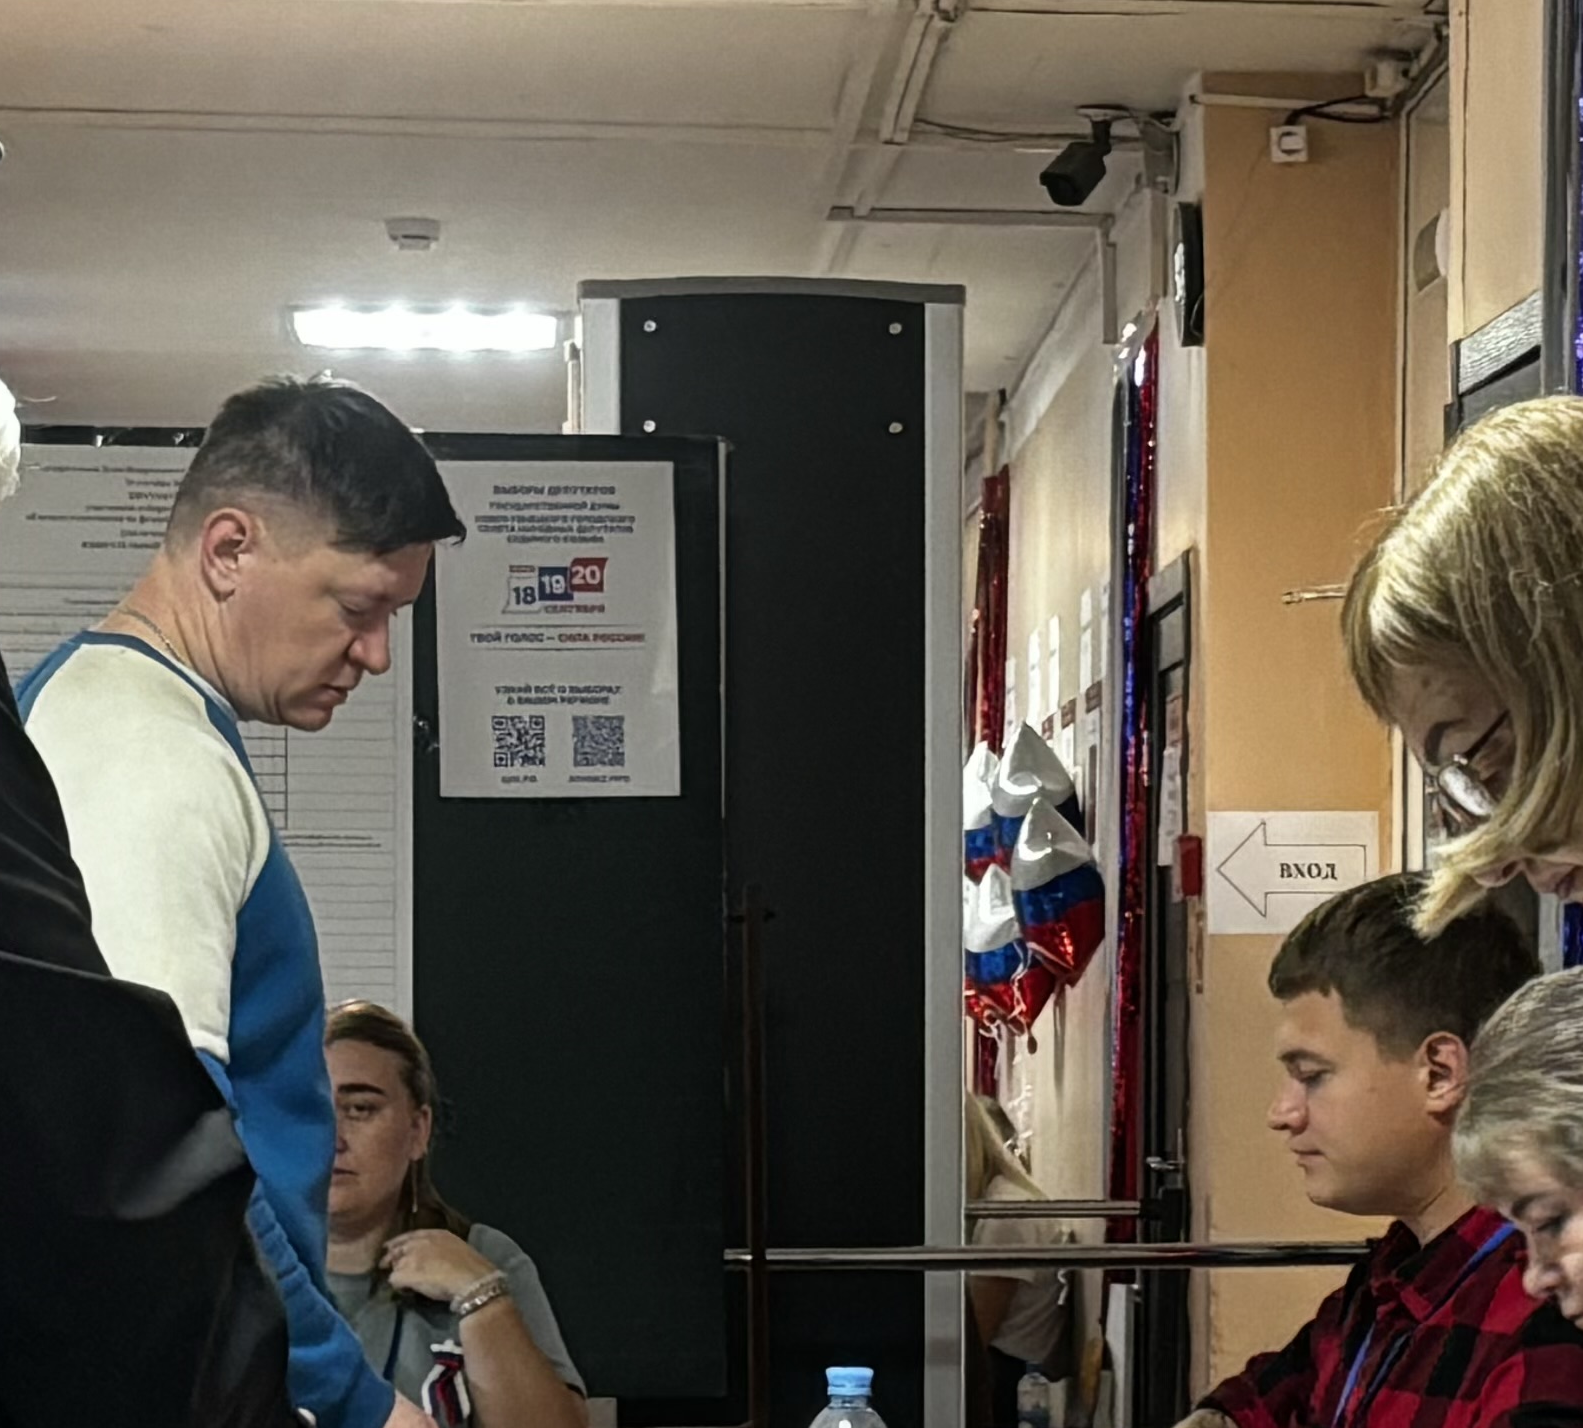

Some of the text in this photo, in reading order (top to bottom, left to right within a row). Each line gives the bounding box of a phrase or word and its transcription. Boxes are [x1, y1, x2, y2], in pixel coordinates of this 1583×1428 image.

[513, 565, 600, 605] 18 19 20
[470, 631, 501, 643] ТВОЙ
[505, 633, 545, 643] ГОЛОС
[1279, 862, 1338, 881] ВХОД
